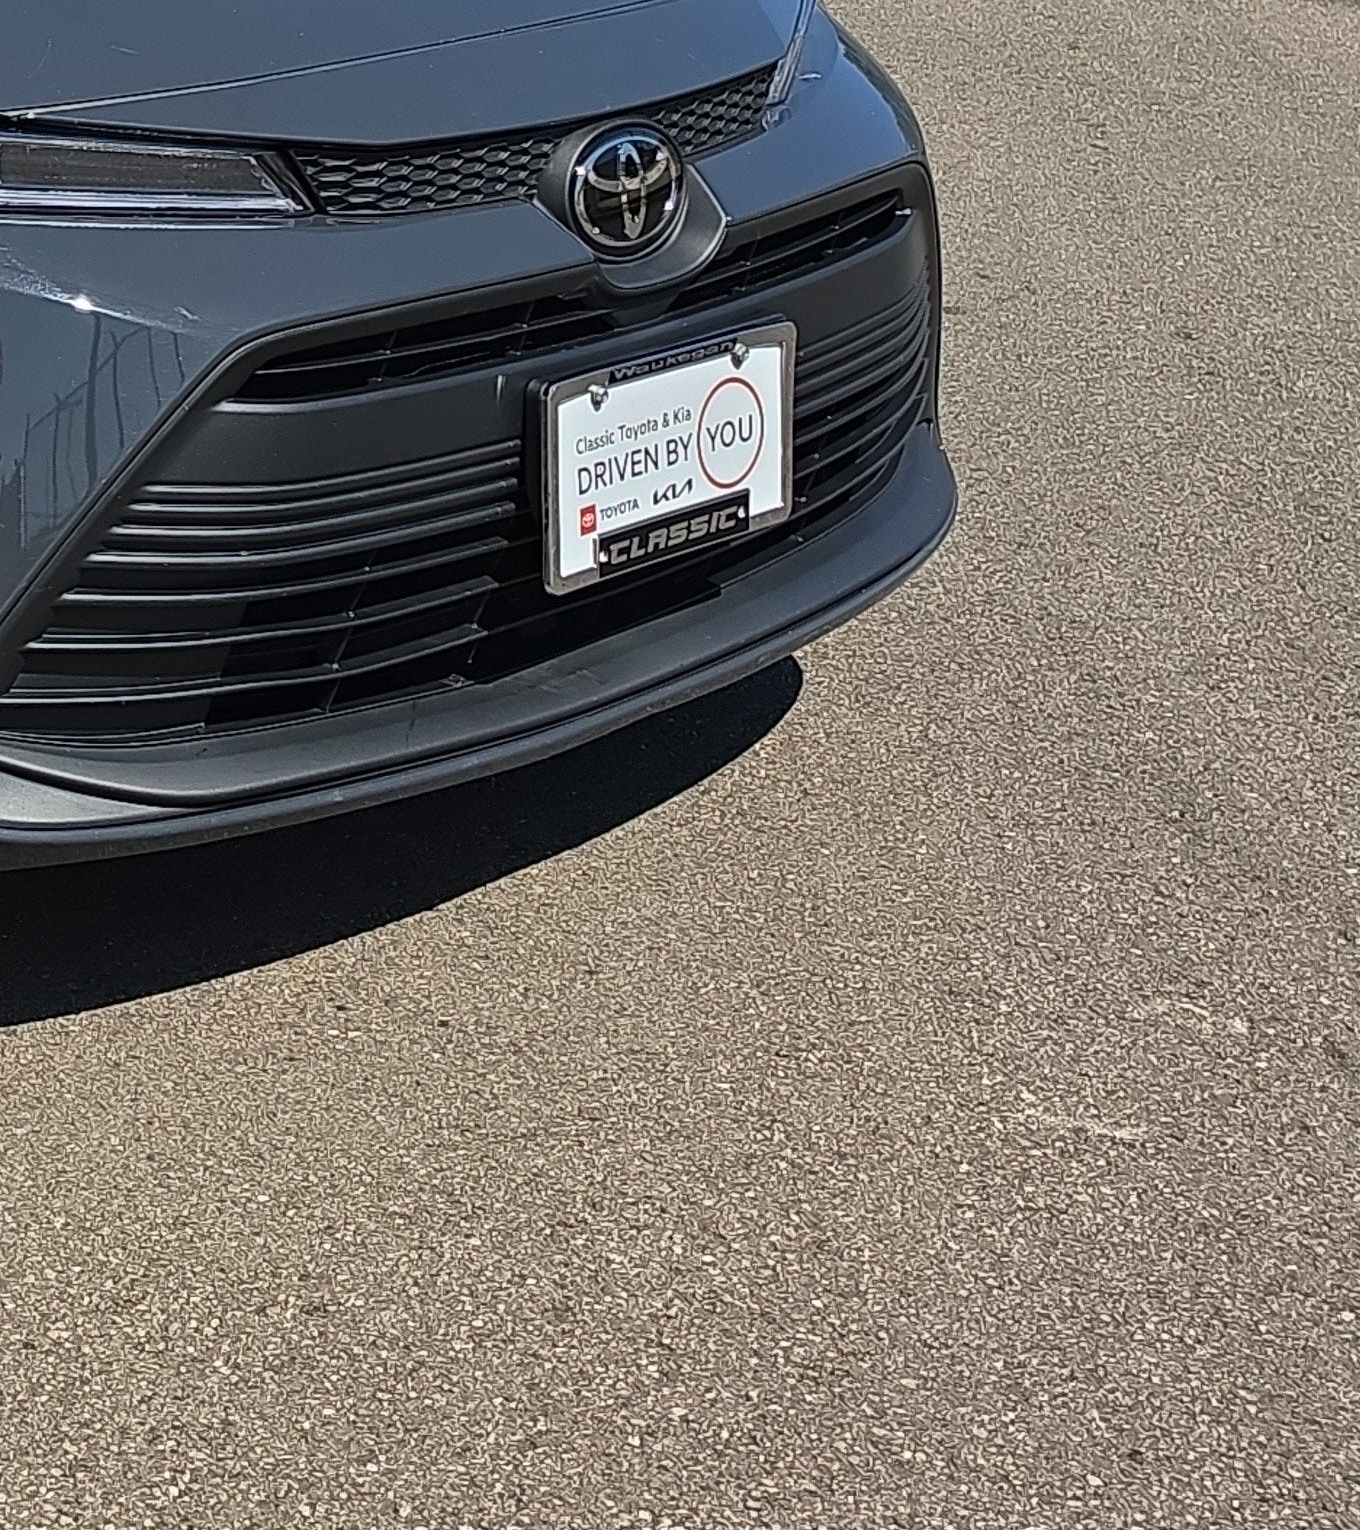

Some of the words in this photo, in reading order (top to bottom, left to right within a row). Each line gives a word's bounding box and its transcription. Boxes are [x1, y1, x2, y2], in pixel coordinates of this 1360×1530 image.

[612, 341, 734, 379] Waukegan
[575, 429, 615, 455] Classic
[617, 419, 658, 445] Toyota
[661, 412, 670, 429] &
[673, 407, 692, 426] Kia
[578, 444, 659, 495] DRIVEN
[666, 433, 692, 467] BY
[706, 415, 753, 452] YOU
[599, 499, 640, 520] TOYOTA
[609, 506, 739, 565] CLASSIC
